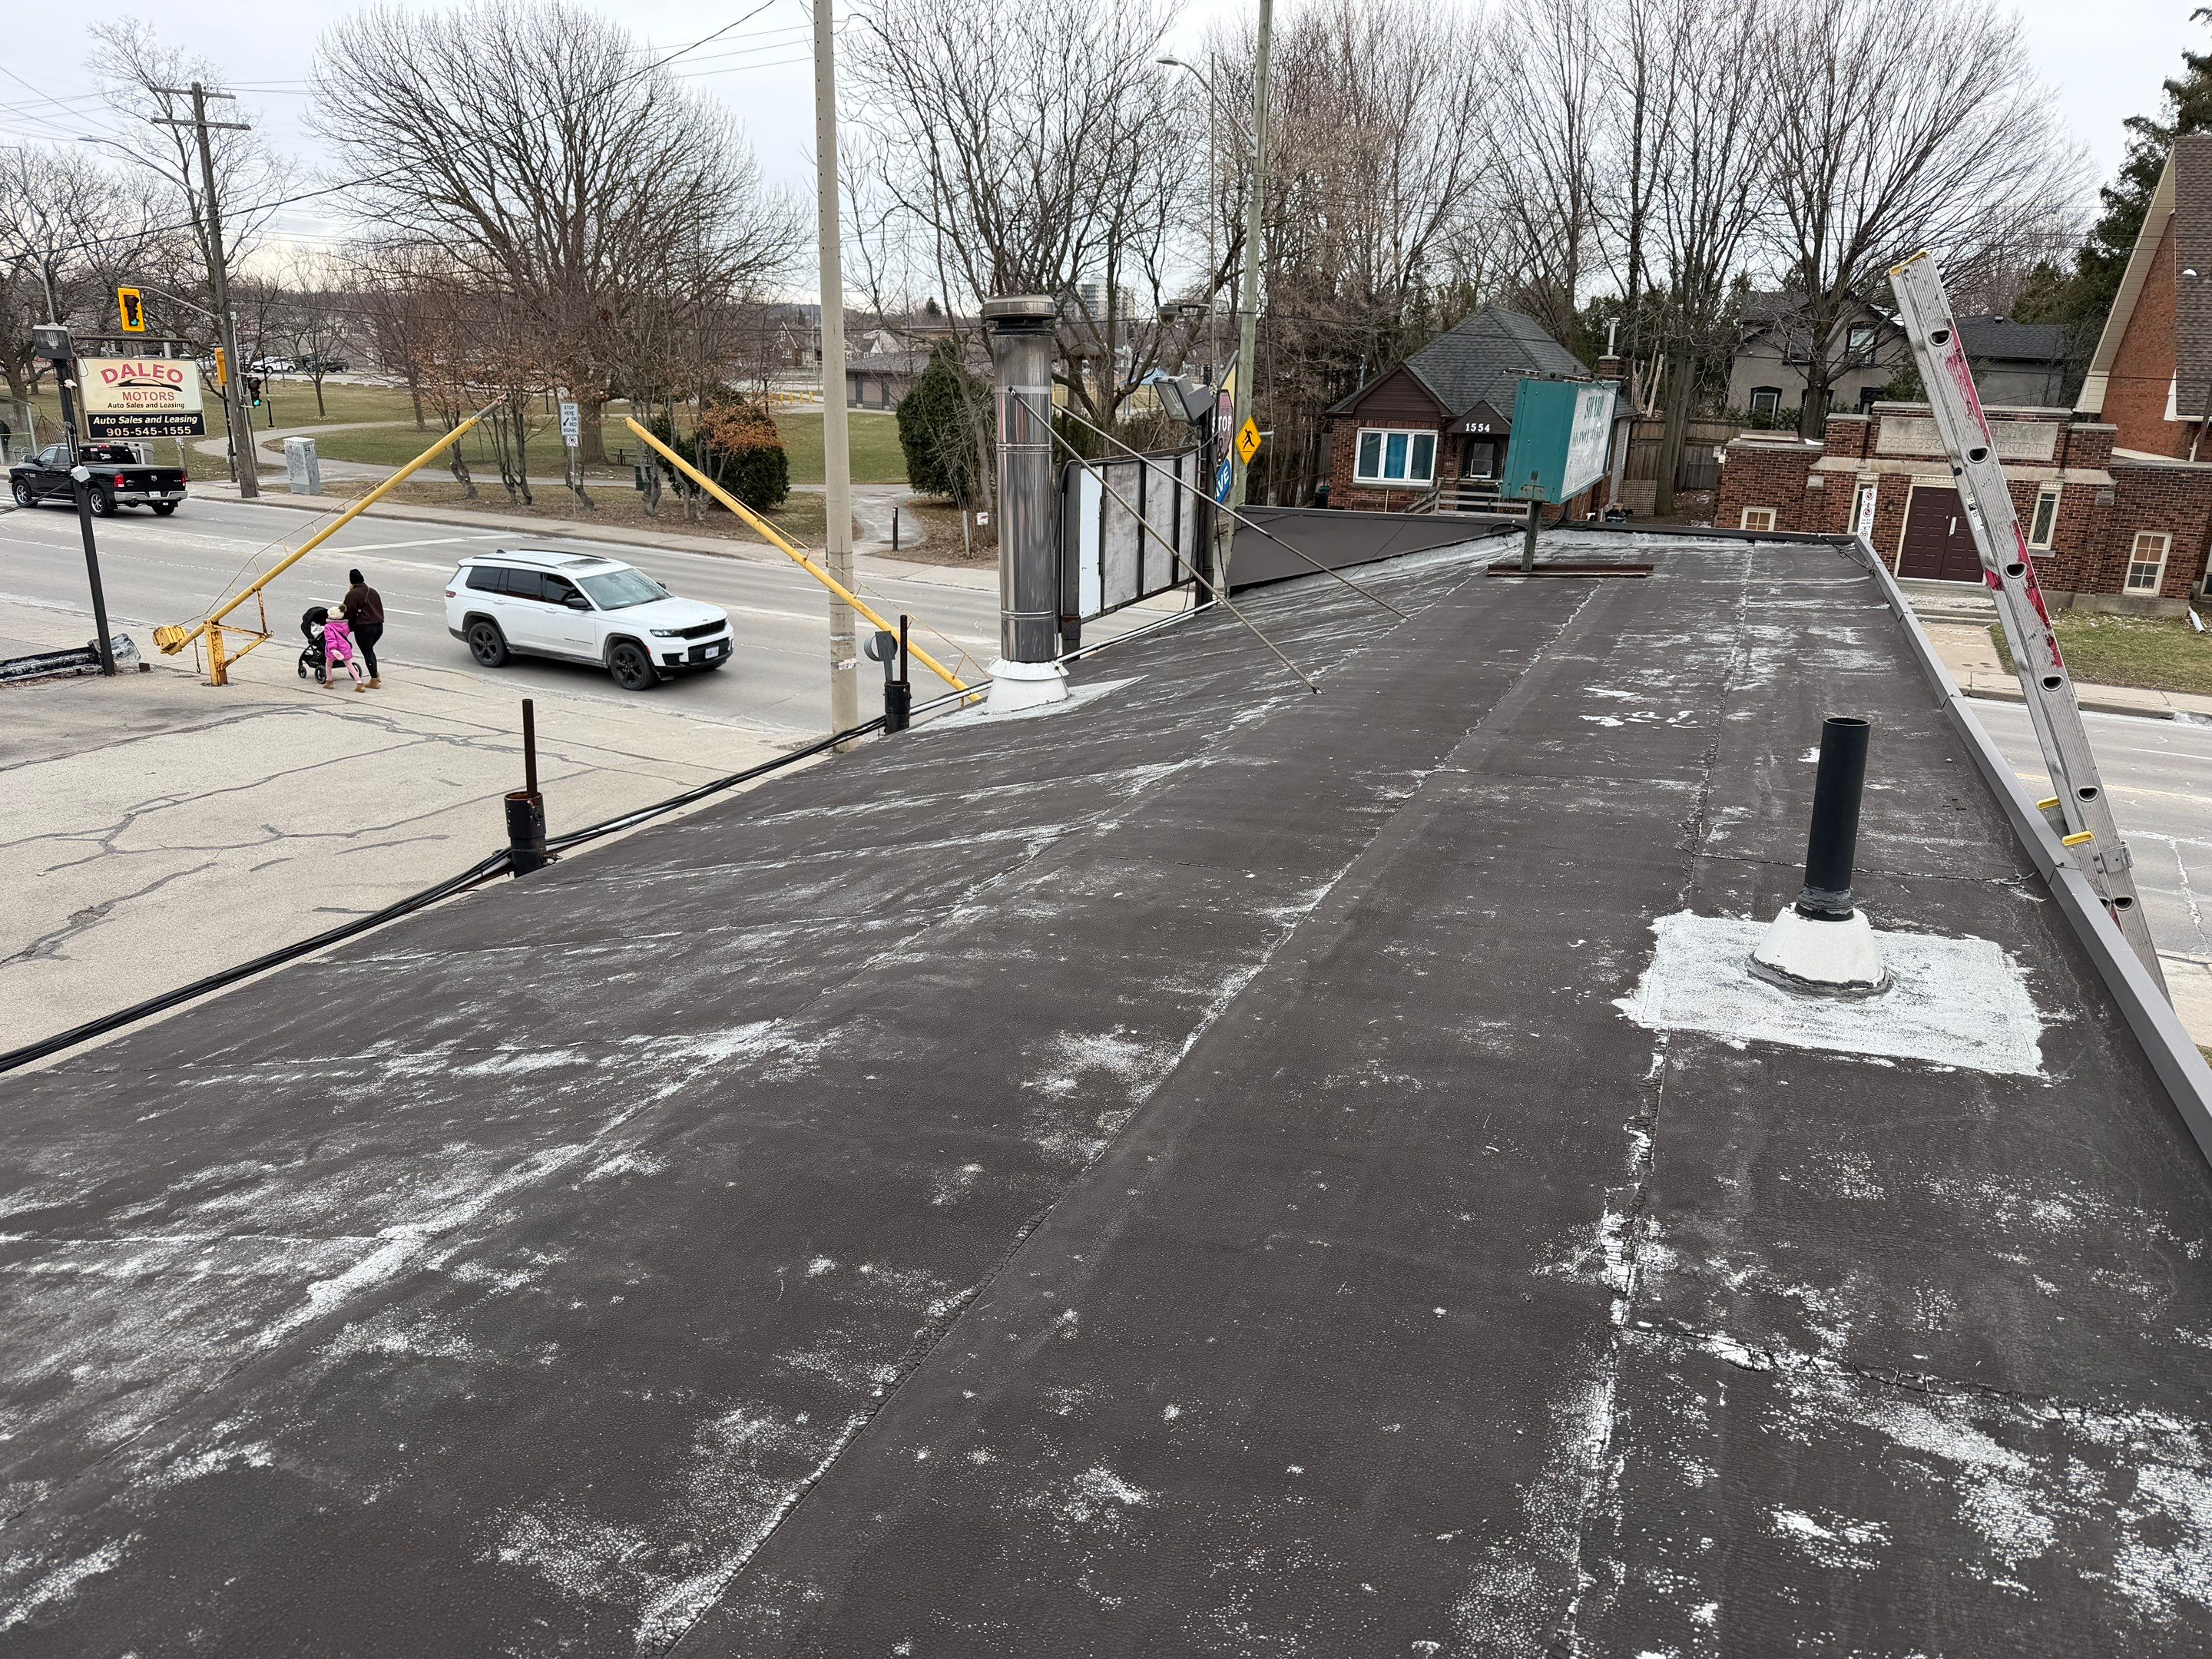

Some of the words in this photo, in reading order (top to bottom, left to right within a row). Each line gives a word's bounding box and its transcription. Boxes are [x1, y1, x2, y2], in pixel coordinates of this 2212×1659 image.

[100, 363, 184, 385] DALEO
[122, 391, 175, 402] MOTORS
[93, 416, 116, 425] Auto
[118, 416, 143, 425] Sales
[144, 415, 162, 424] and
[164, 415, 198, 425] Leasing
[106, 426, 191, 437] 905-545-1555
[1465, 422, 1491, 432] 1554
